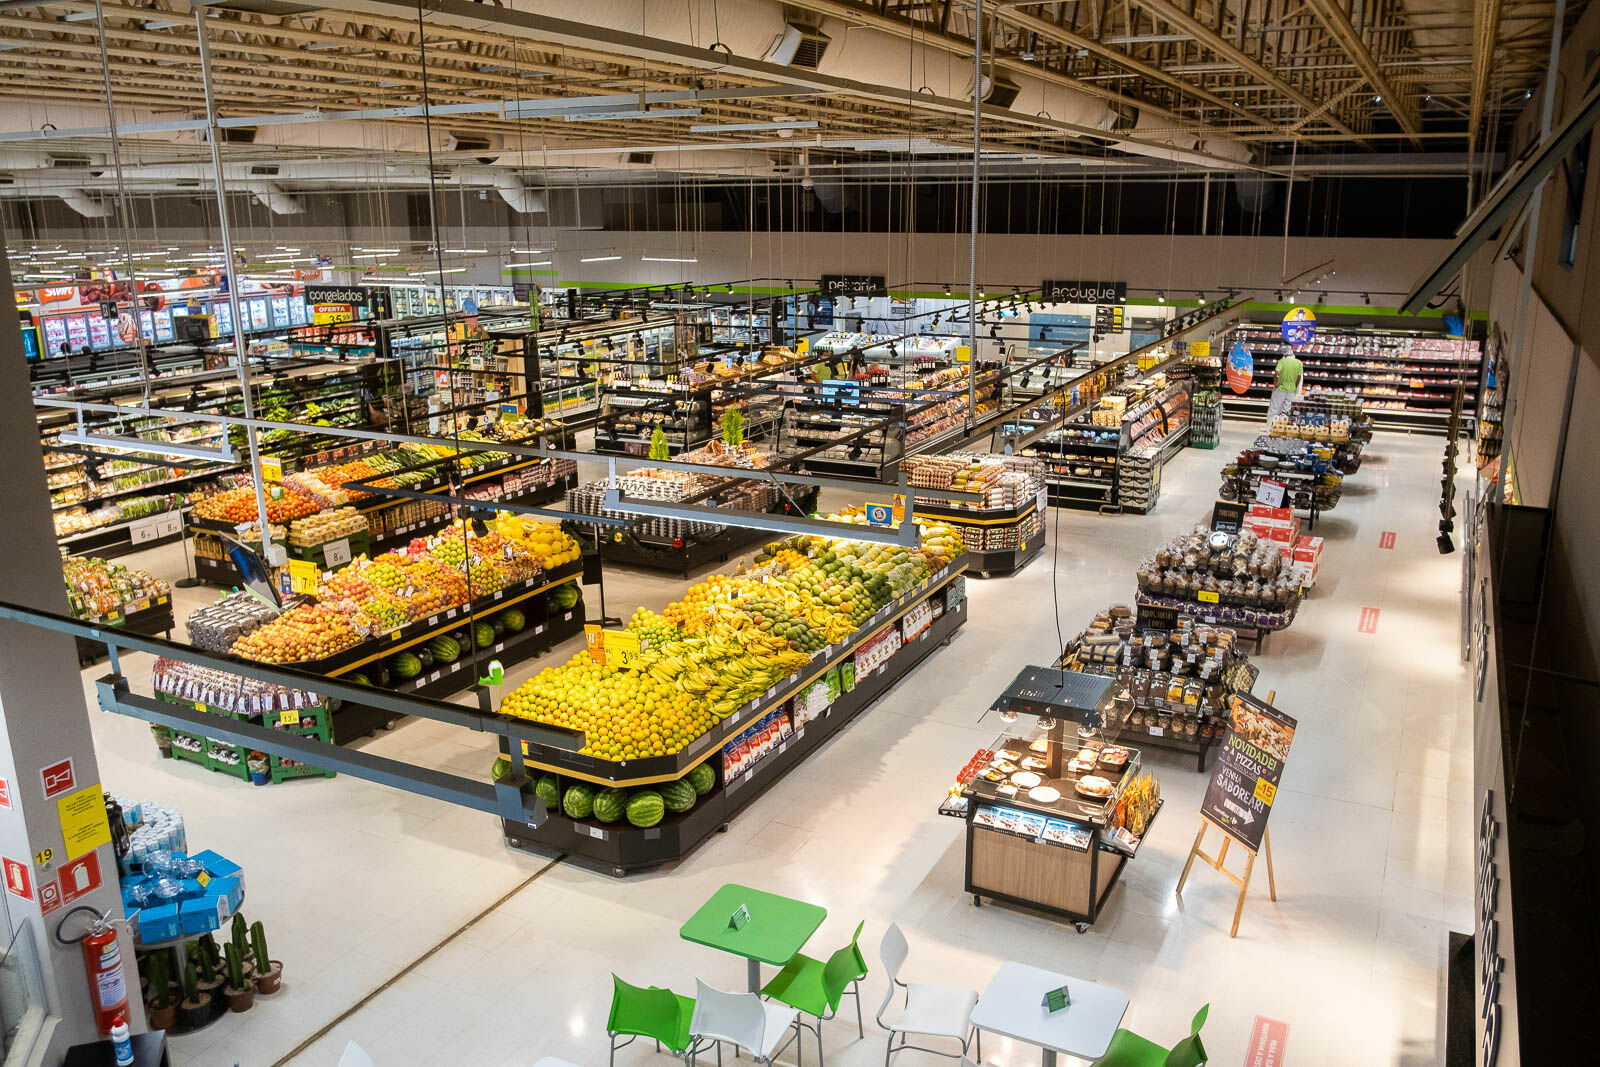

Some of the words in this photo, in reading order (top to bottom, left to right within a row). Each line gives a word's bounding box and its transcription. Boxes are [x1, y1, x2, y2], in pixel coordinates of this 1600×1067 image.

[309, 288, 363, 303] congelados
[621, 650, 628, 665] 3
[1228, 734, 1278, 771] NOVIDADE!
[1235, 752, 1262, 775] PIZZAS
[1222, 766, 1242, 785] VENHA
[1216, 773, 1265, 814] SABOREAR!
[1262, 784, 1274, 798] 15
[36, 848, 53, 863] 19
